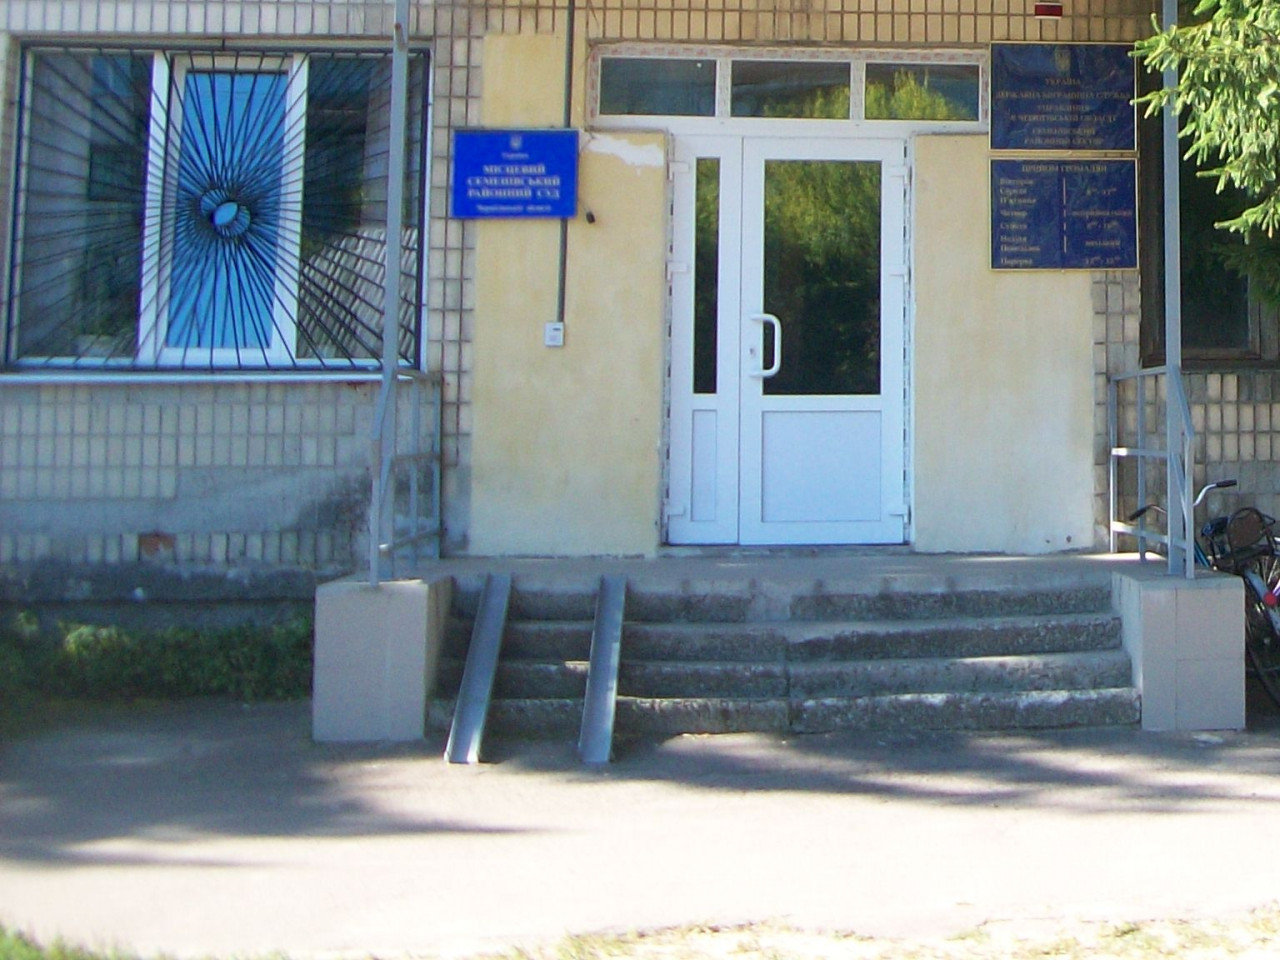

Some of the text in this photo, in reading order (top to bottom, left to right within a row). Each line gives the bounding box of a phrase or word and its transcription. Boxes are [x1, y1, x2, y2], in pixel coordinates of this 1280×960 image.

[483, 162, 546, 174] МІСЦЕВИЙ
[467, 175, 560, 186] СЕМЕНІВСЬКИЙ
[468, 186, 561, 199] РАЙОННИЙ СУД
